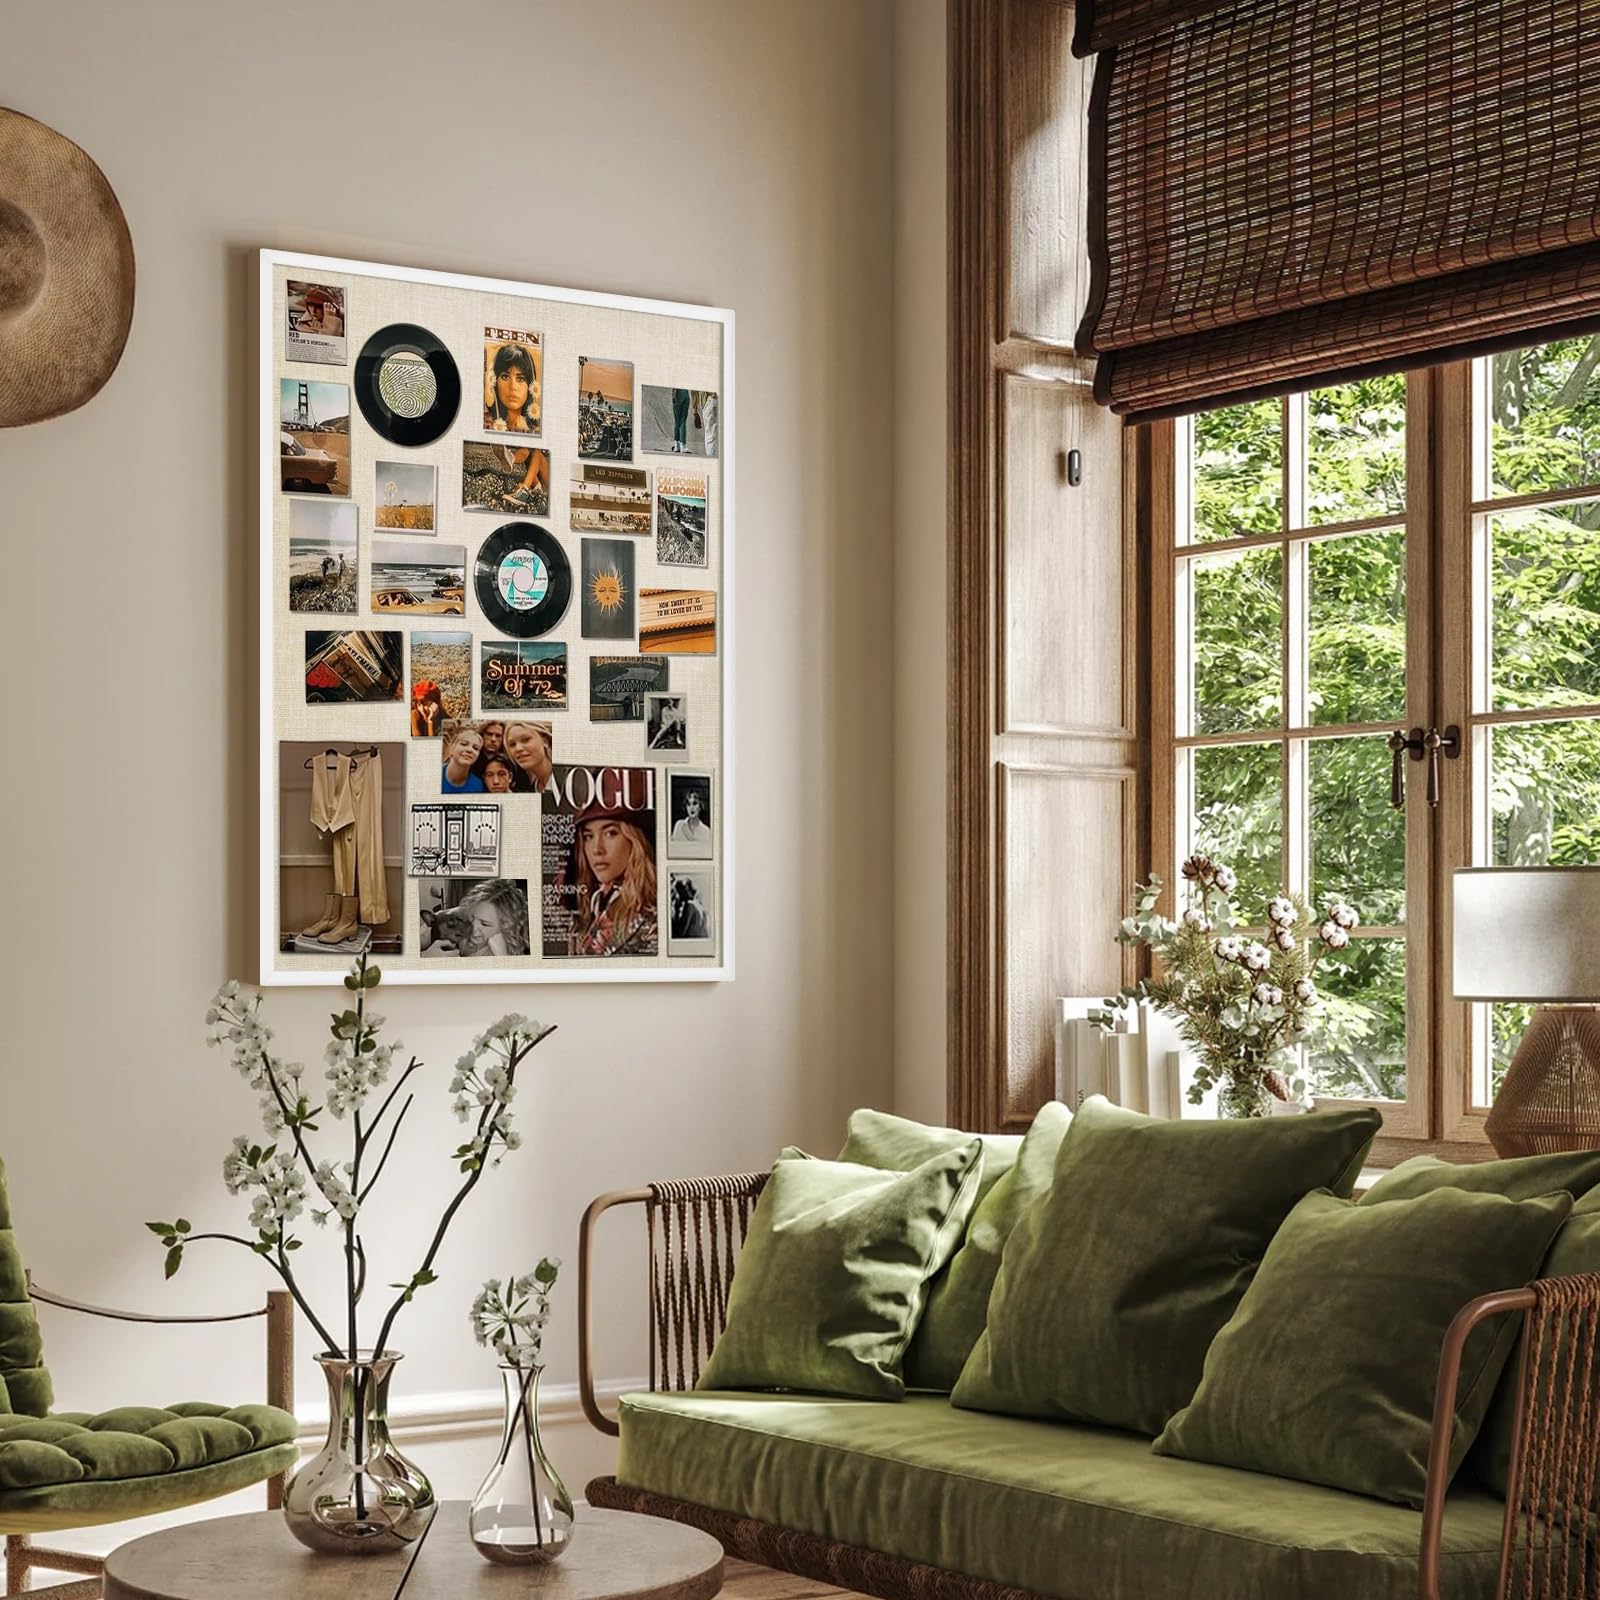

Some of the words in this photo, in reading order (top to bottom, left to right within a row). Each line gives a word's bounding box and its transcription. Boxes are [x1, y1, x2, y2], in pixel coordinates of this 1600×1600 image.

[484, 327, 540, 345] TEEN
[657, 484, 706, 498] CALIFORNIA
[486, 659, 563, 680] Summer
[504, 678, 526, 698] Of
[542, 813, 575, 825] BRIGHT
[542, 824, 576, 834] YOUNG
[542, 832, 576, 845] THINGS
[542, 884, 588, 895] SPARKING
